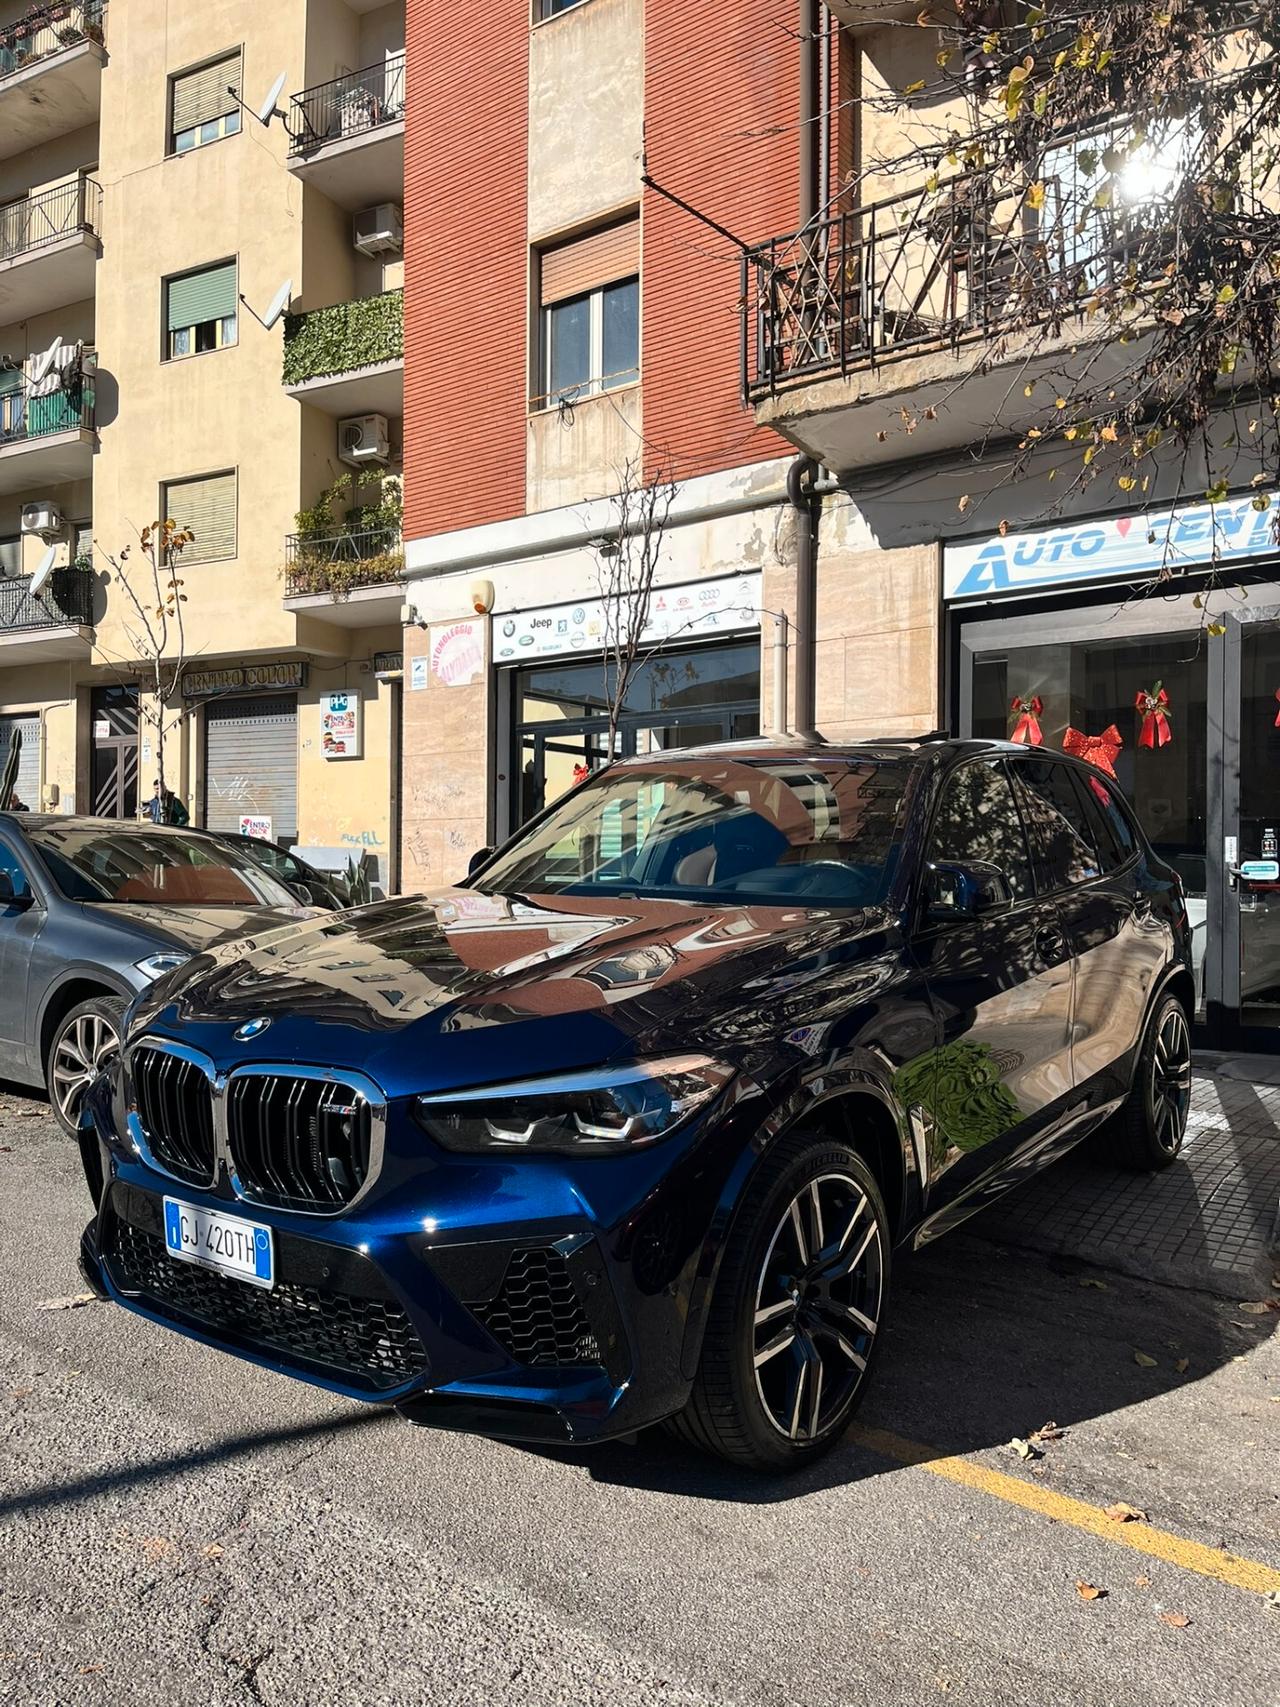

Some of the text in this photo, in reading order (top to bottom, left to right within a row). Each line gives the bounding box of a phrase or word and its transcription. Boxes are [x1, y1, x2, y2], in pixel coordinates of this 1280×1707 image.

[953, 529, 1106, 595] AUTO
[530, 618, 552, 629] Jeep
[246, 664, 299, 686] COLOR
[330, 696, 348, 709] PPG
[206, 1223, 256, 1265] 420TH
